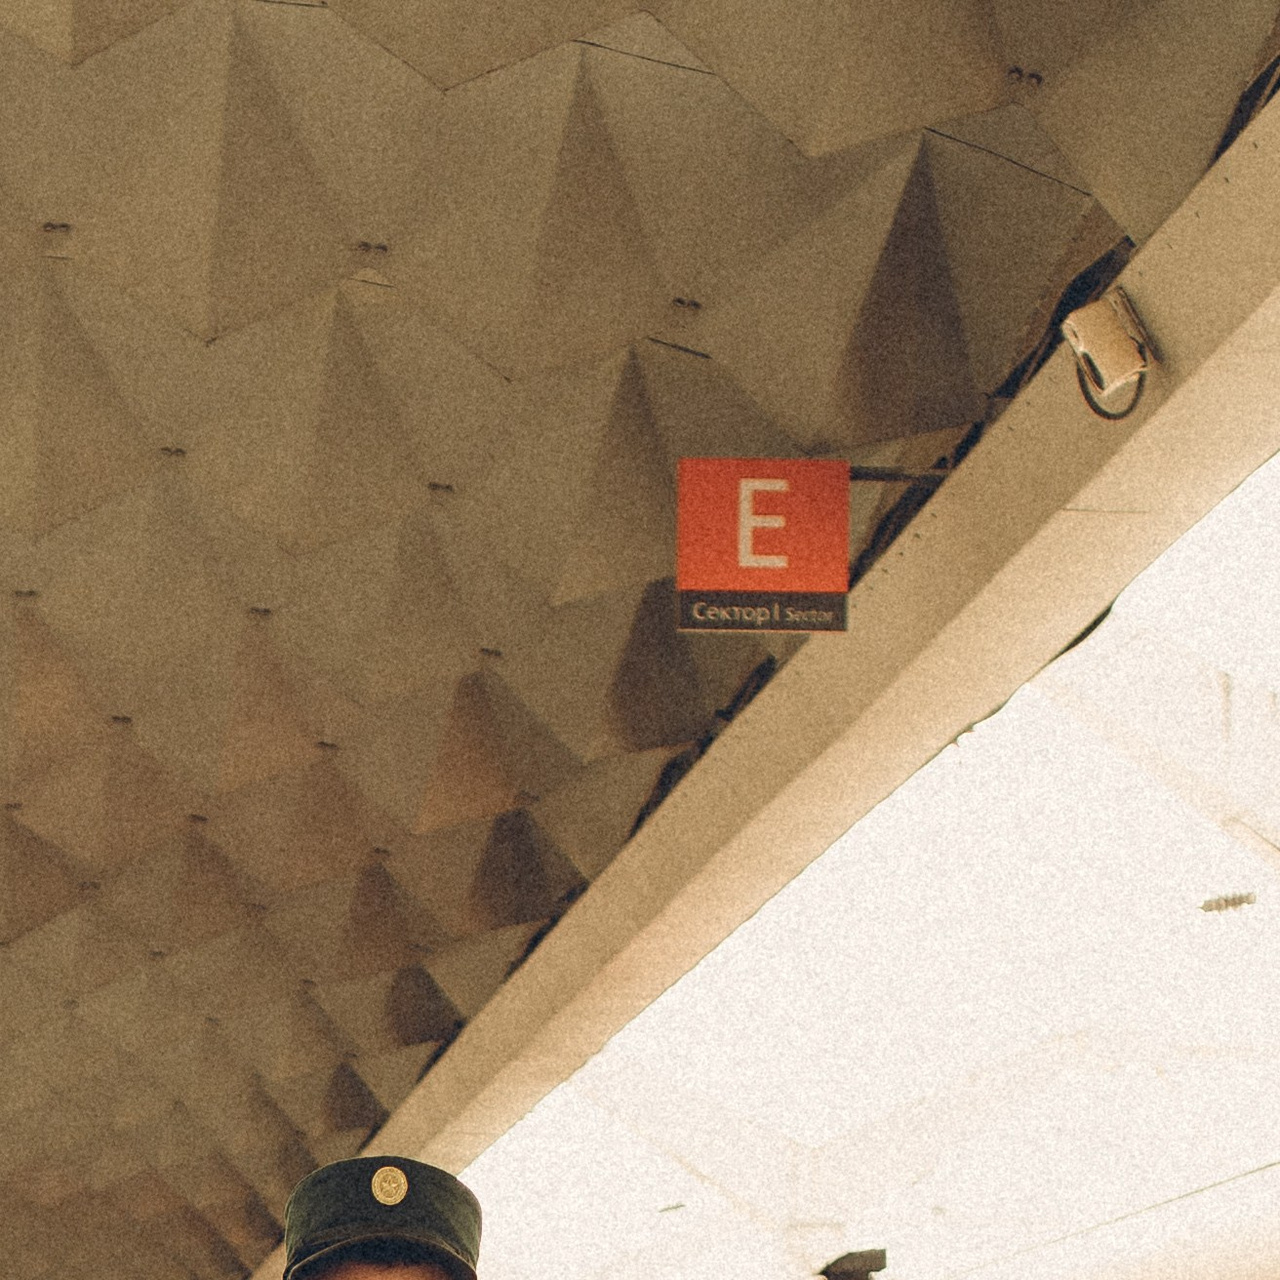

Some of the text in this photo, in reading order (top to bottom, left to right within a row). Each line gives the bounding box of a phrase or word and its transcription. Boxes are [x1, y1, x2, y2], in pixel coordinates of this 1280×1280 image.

[738, 478, 789, 568] E
[692, 602, 833, 625] Сектор Sector
